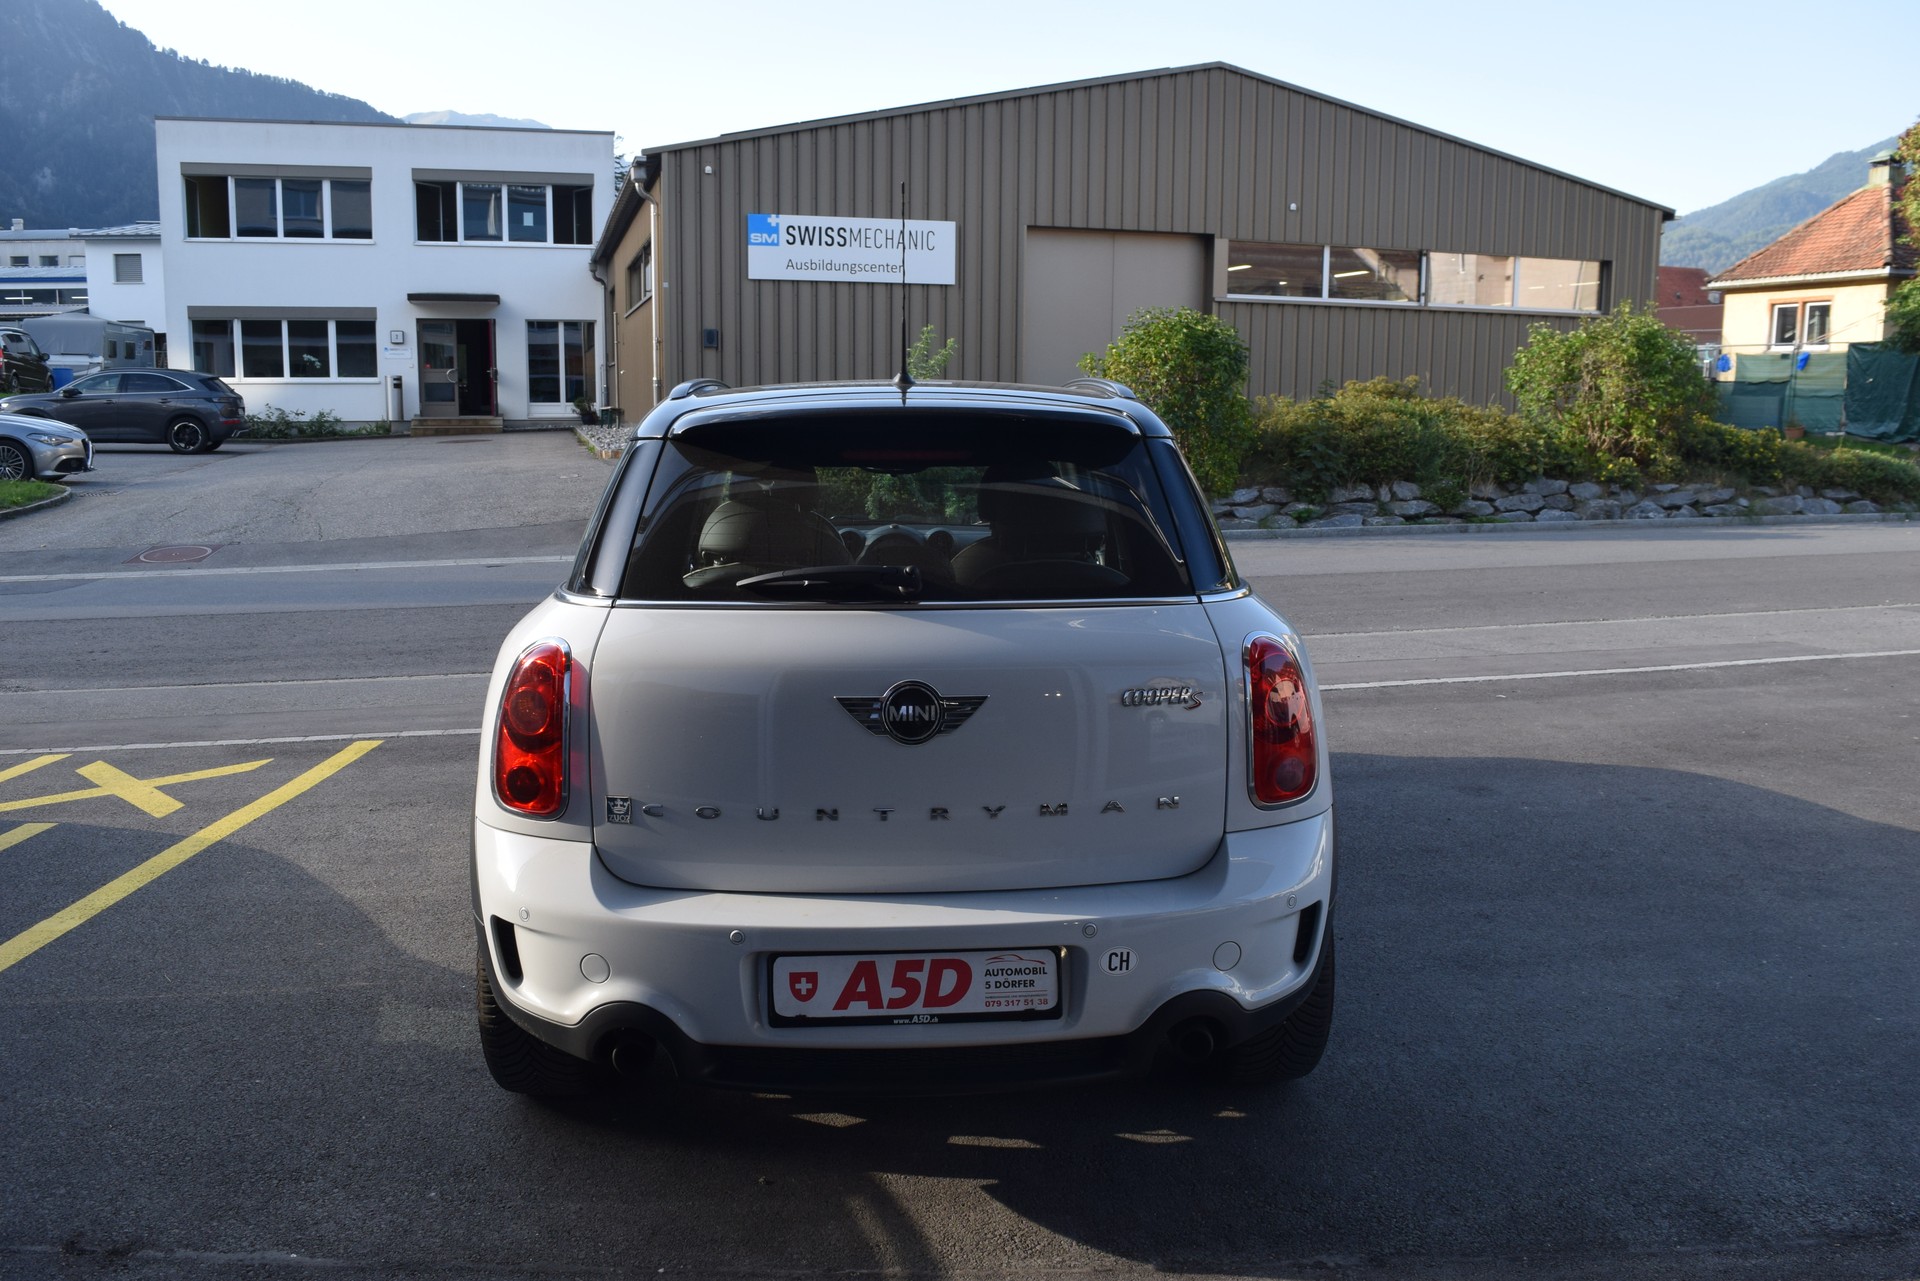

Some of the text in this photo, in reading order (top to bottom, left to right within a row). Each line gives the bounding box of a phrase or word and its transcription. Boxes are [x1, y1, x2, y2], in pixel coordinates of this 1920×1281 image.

[786, 225, 936, 251] SWISSMECHANIC
[786, 258, 904, 275] Ausbildungscenter
[889, 705, 936, 721] MINI
[643, 796, 1179, 822] COUNTRYMAN
[1107, 951, 1131, 972] CH
[984, 966, 1048, 977] AUTOMOBIL
[832, 958, 973, 1011] A5D
[985, 977, 1035, 990] 5 DÖRFER
[985, 998, 1049, 1008] 079 317 51 38
